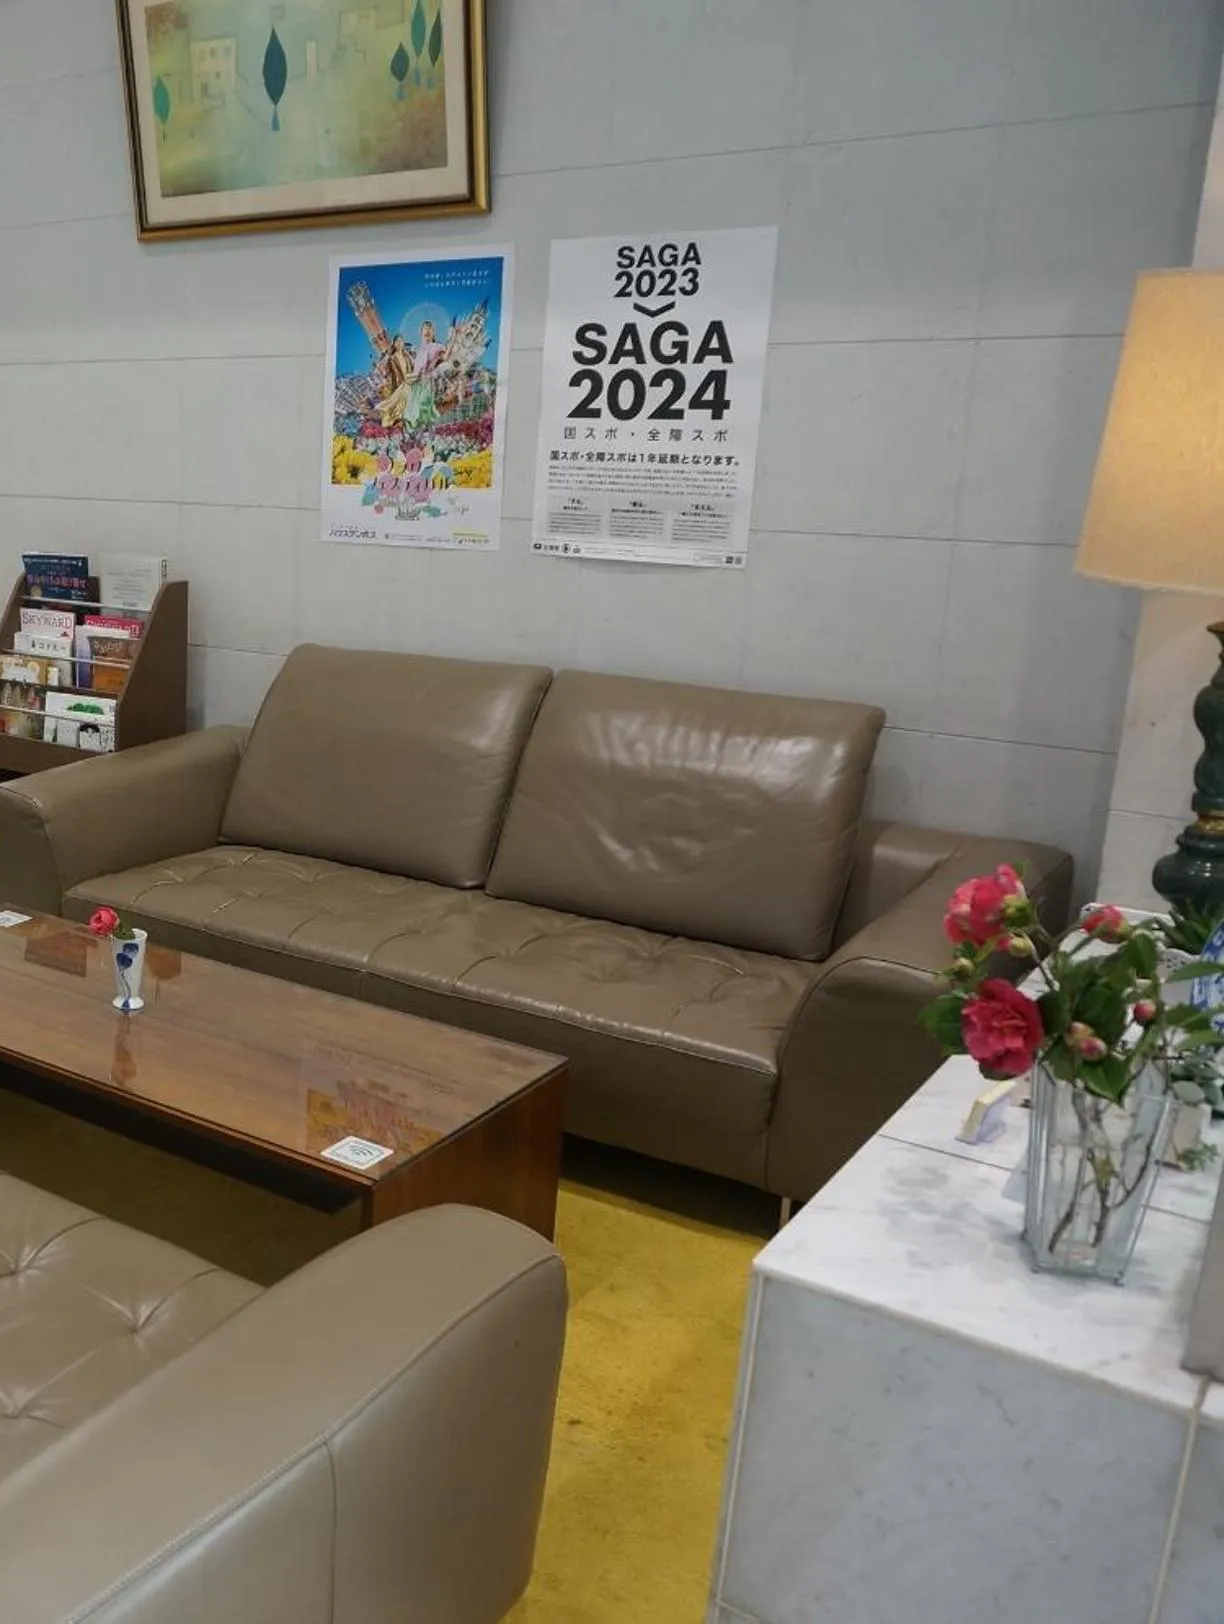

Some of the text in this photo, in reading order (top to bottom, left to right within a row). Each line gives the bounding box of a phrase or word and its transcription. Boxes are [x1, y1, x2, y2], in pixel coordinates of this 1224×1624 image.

[616, 242, 702, 269] SAGA
[613, 267, 700, 298] 2023
[572, 320, 734, 366] SAGA
[566, 367, 732, 421] 2024
[22, 611, 73, 630] SKYWARD
